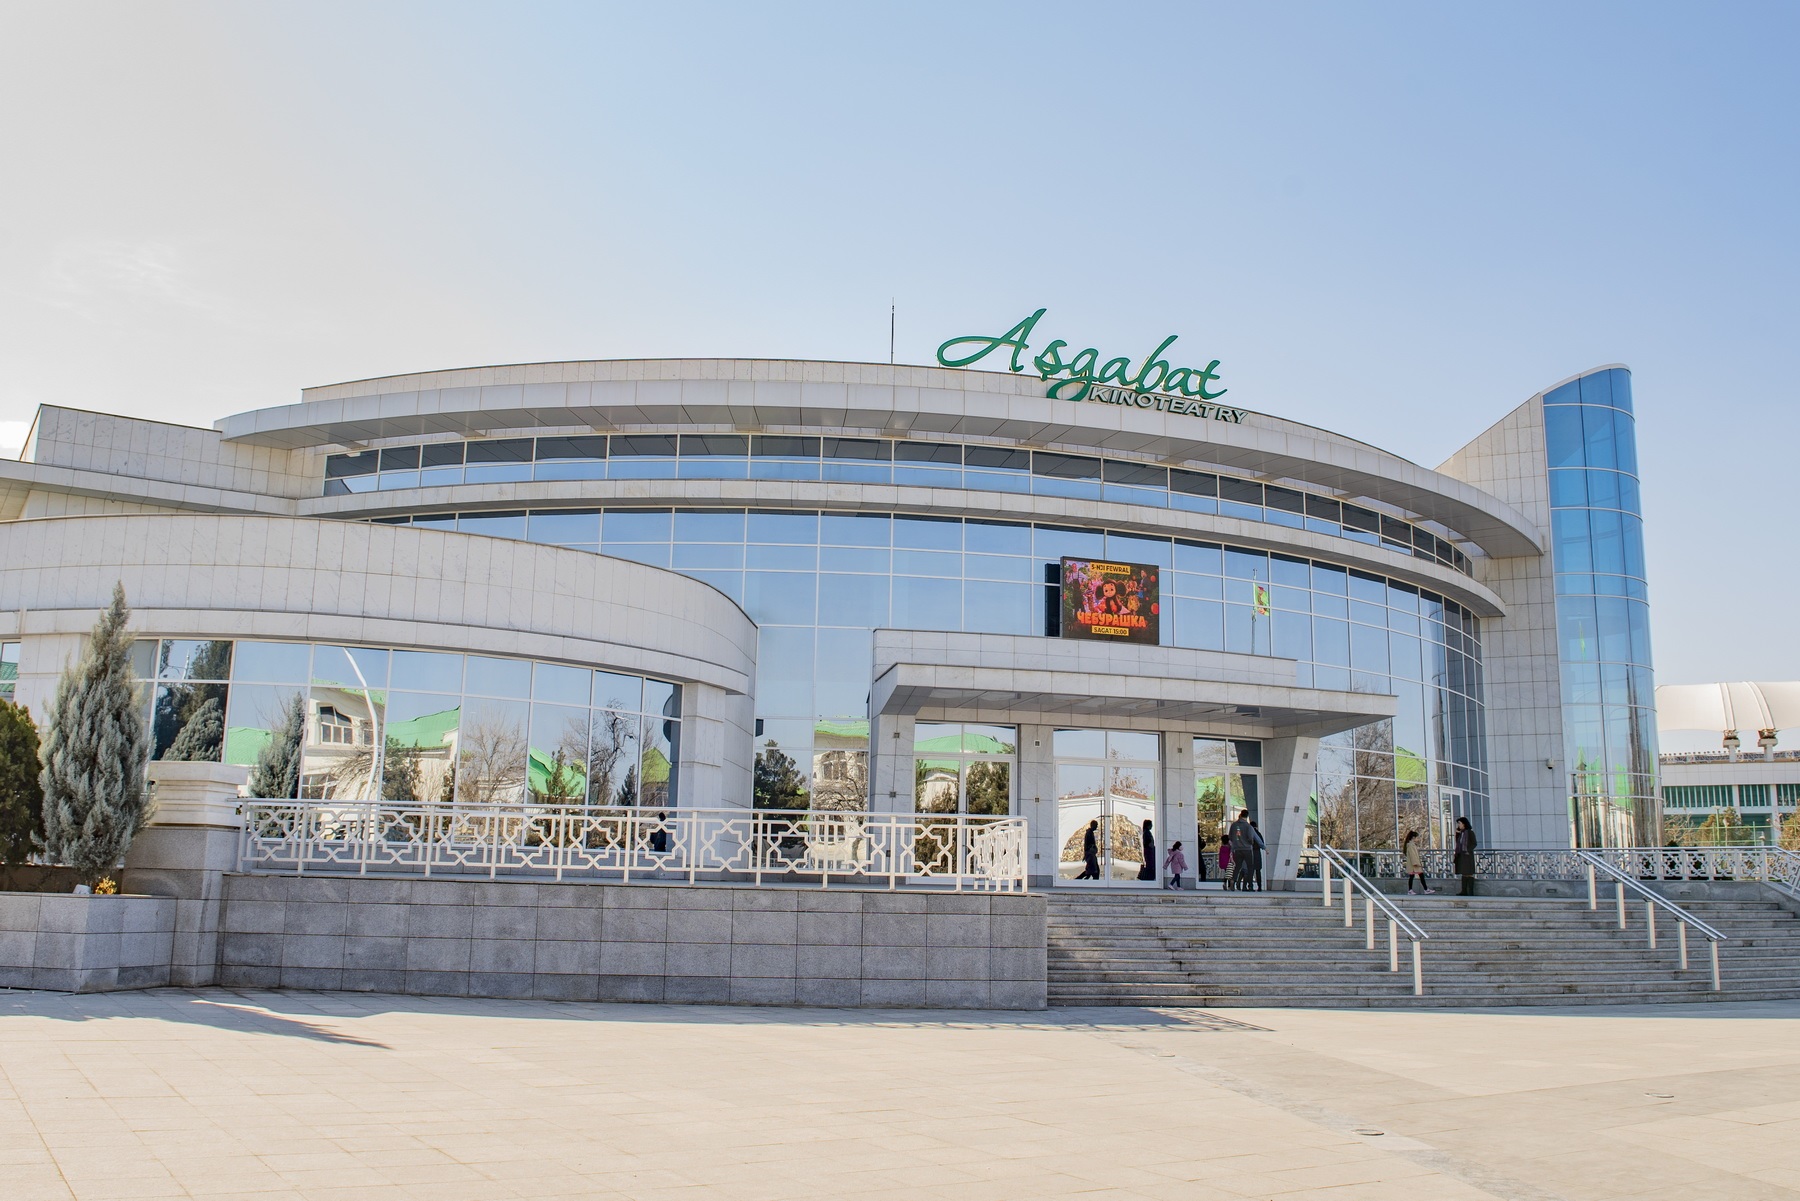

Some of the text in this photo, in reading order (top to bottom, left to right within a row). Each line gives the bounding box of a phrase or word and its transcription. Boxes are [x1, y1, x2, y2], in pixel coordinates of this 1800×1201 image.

[937, 308, 1228, 402] Aşgabat
[1088, 386, 1249, 424] KINOTEATRY
[1106, 565, 1129, 573] FEWRAL
[1077, 611, 1147, 627] ЧЕБУРАШКА
